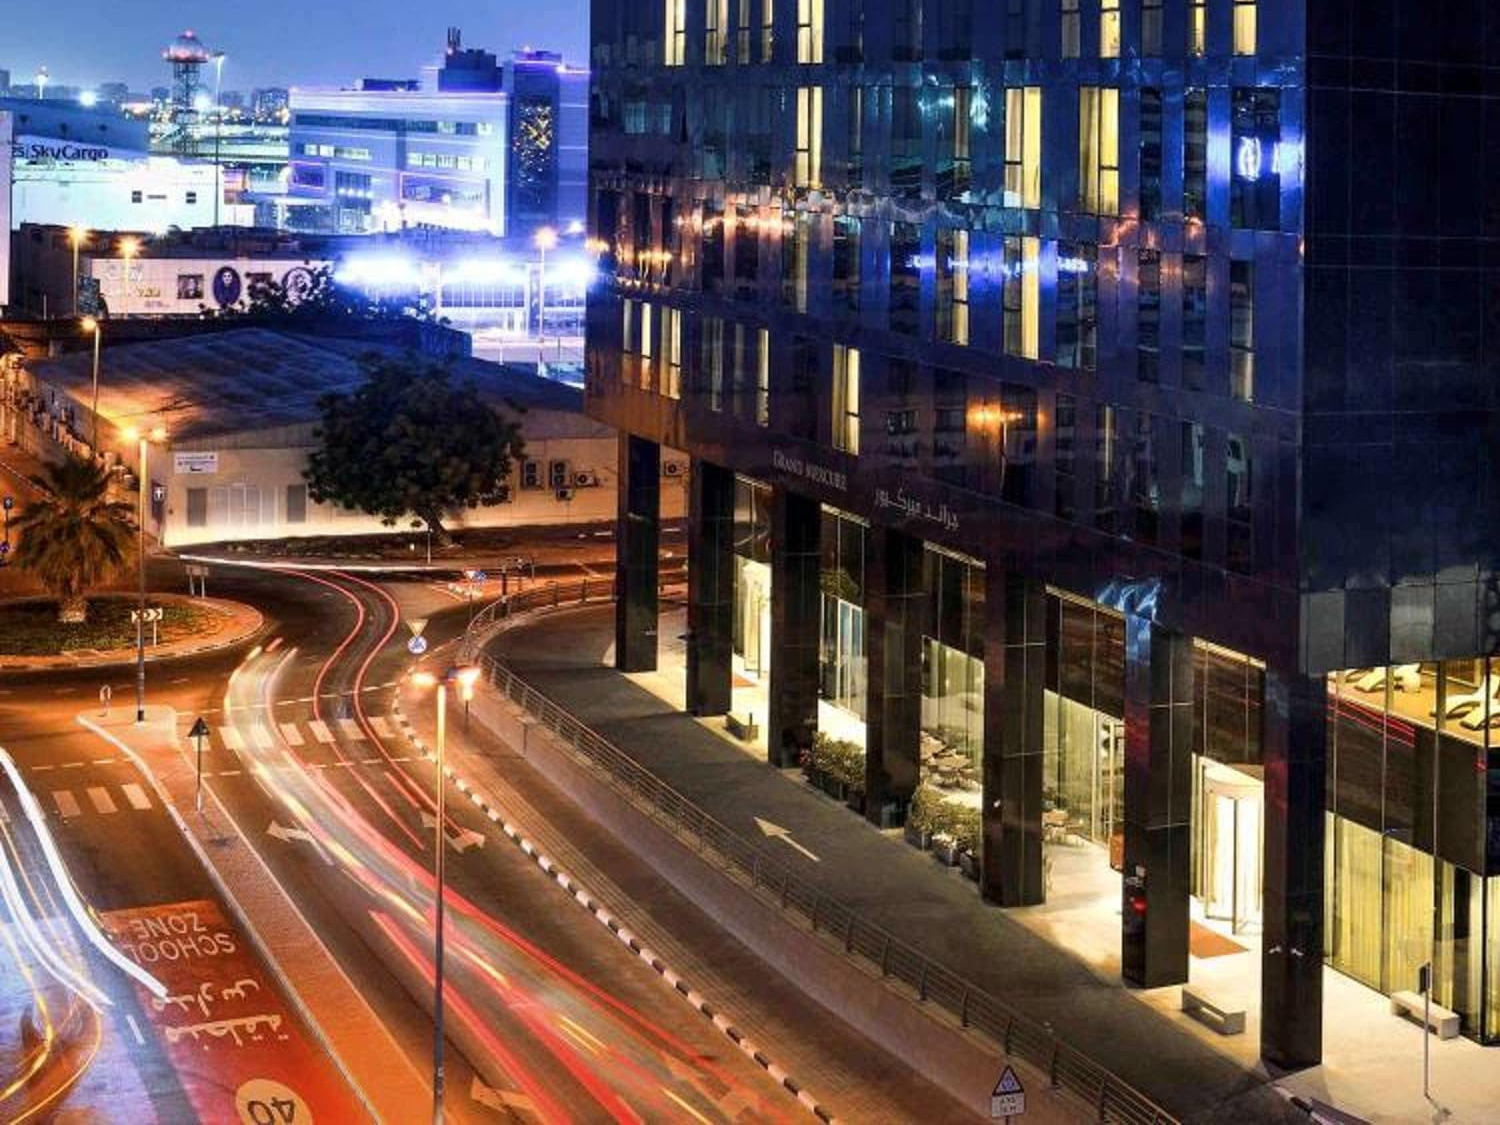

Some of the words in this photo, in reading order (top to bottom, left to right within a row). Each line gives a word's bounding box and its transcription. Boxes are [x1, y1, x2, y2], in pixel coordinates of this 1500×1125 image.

[31, 144, 109, 162] SkyCargo
[129, 913, 207, 940] ZONE
[123, 933, 236, 964] SCHOOL
[165, 1015, 289, 1051] منطقة
[248, 1097, 295, 1125] 40
